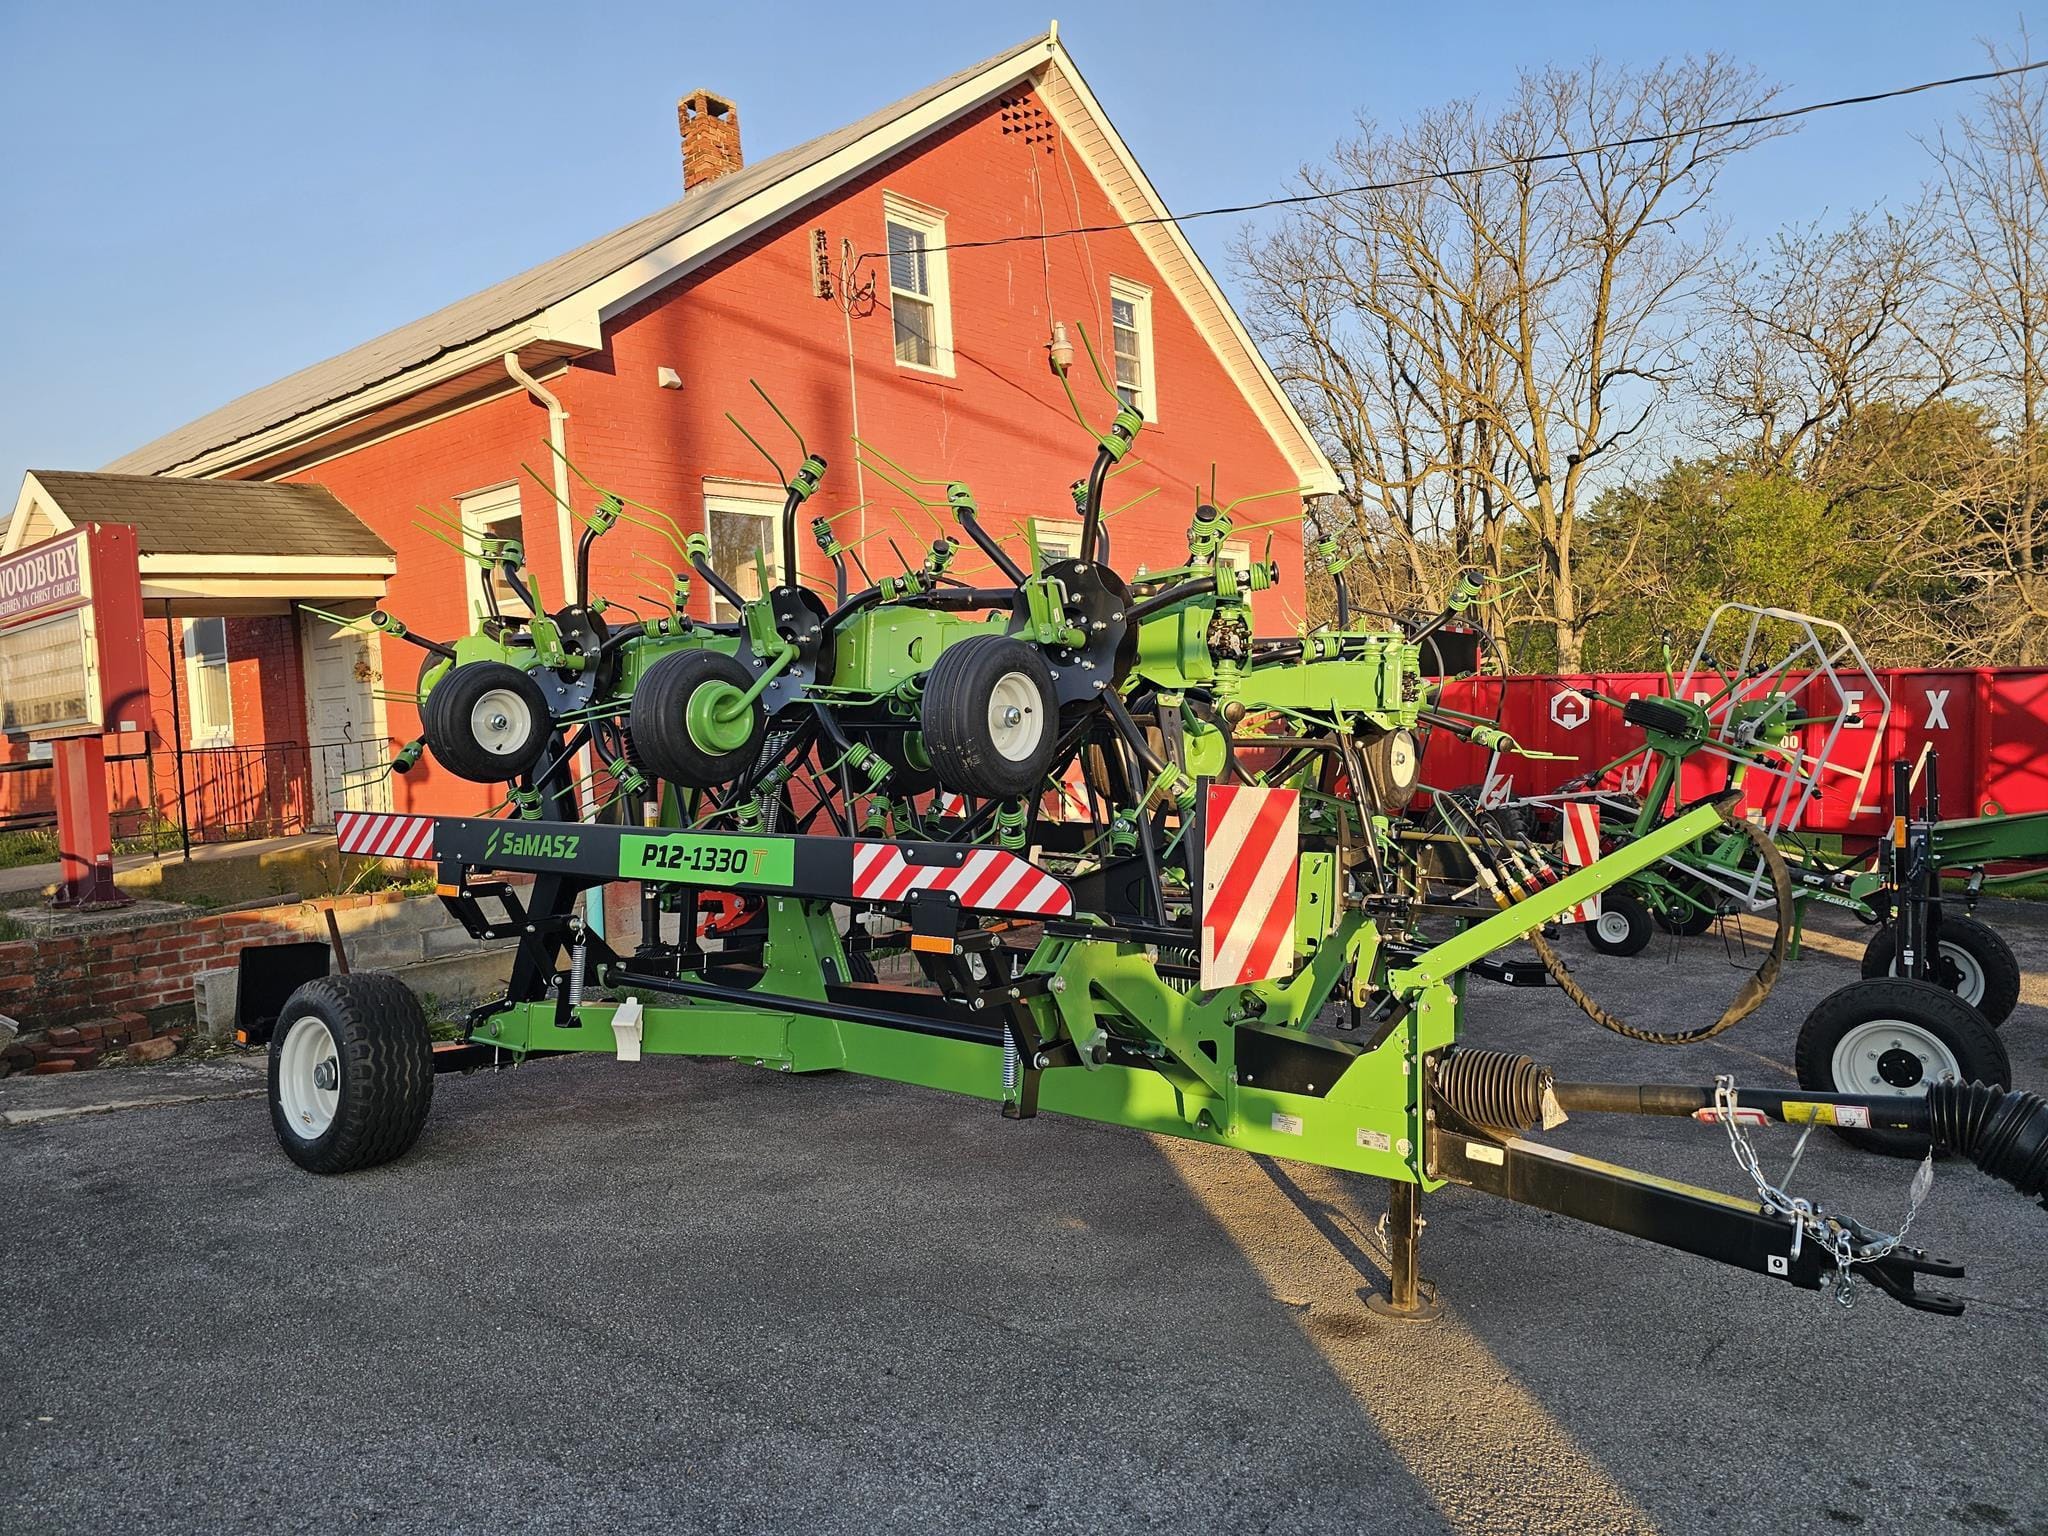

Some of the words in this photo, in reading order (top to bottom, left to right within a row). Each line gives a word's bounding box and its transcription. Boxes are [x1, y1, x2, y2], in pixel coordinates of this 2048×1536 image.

[0, 597, 20, 615] ETHREN
[22, 593, 30, 609] IN
[31, 587, 51, 605] CHRIST
[52, 578, 80, 599] CHURCH
[1777, 735, 1799, 749] 00
[501, 832, 580, 859] SaMASZ
[641, 843, 748, 874] P12-1330
[753, 849, 769, 876] T
[1823, 895, 1861, 910] SaMASZ
